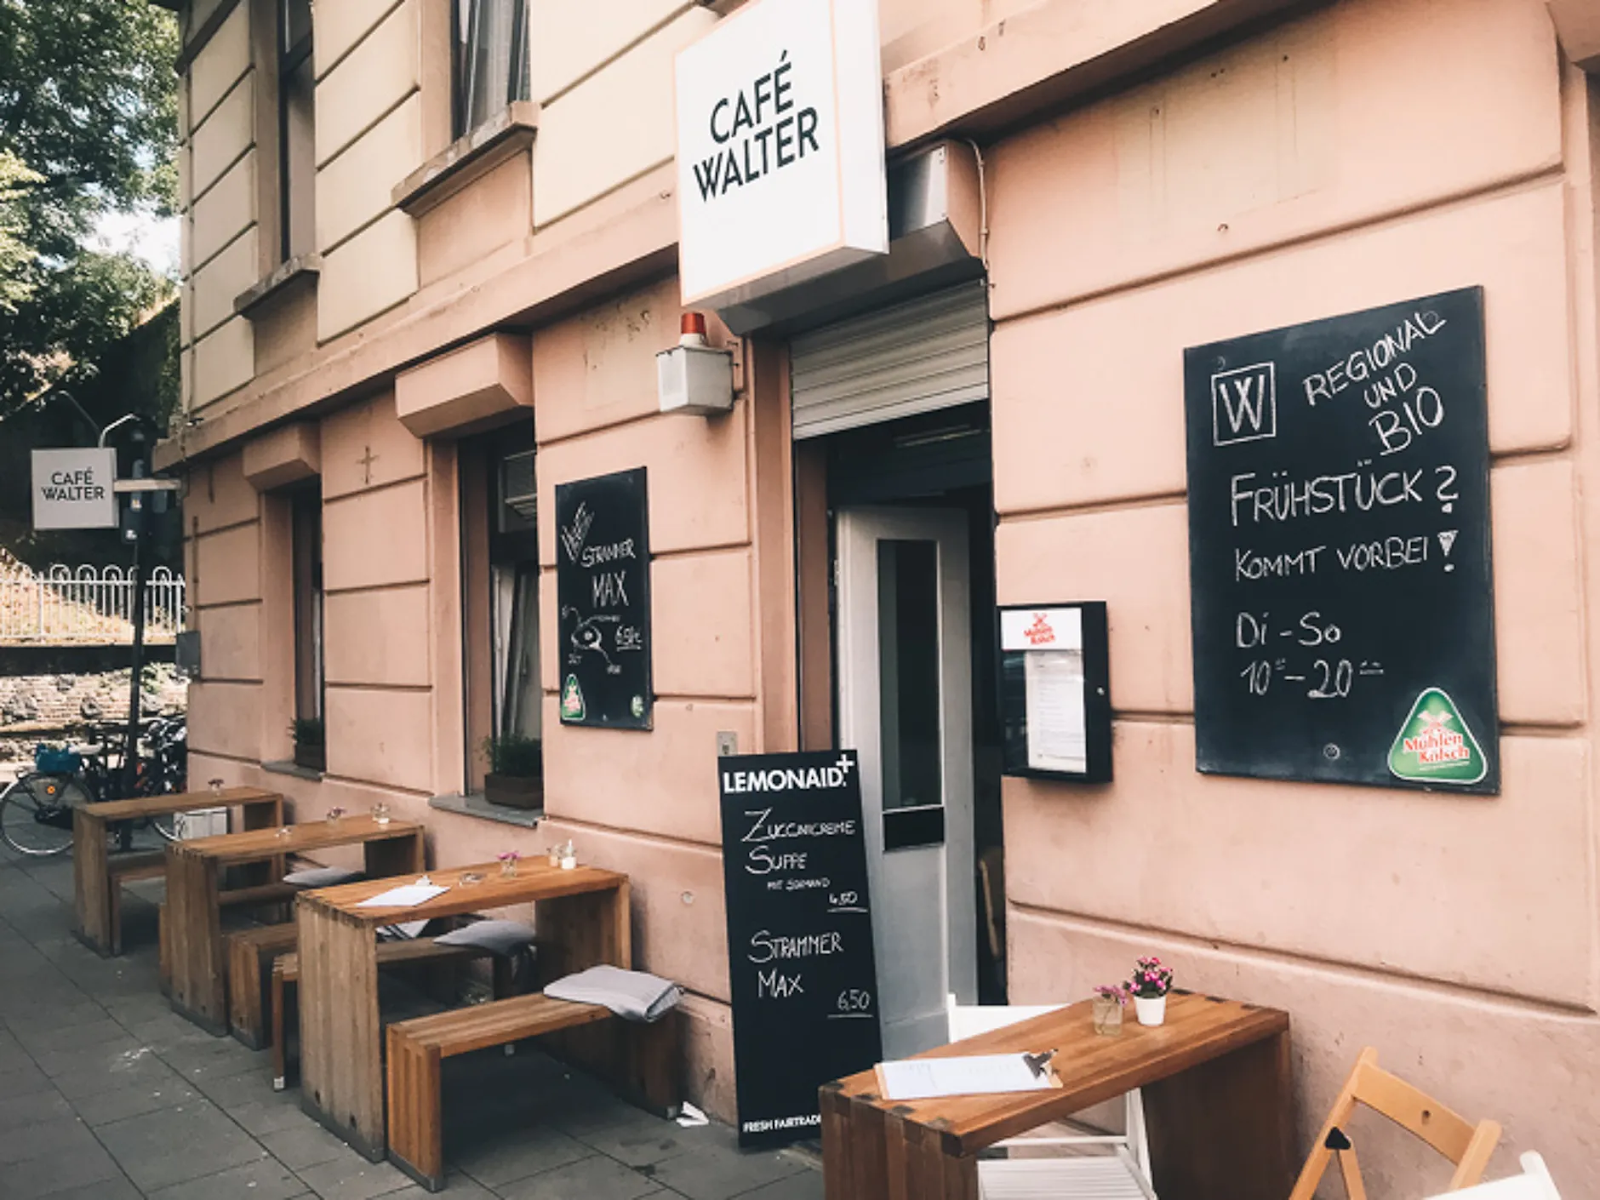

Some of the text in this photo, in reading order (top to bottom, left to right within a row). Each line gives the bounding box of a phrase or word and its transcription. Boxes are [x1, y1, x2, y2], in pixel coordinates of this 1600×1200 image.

[710, 49, 794, 144] CAFÉ
[693, 106, 819, 202] WALTER
[1303, 311, 1447, 406] REGIONAL
[1364, 362, 1417, 408] UND
[1368, 386, 1444, 456] BIO
[41, 486, 105, 501] WALTER
[51, 467, 94, 485] CAFÉ
[1235, 545, 1326, 581] KOMMT
[592, 570, 630, 608] MAX
[744, 845, 808, 875] SUPPE
[747, 930, 844, 963] STRAMMER
[757, 968, 804, 998] MAX
